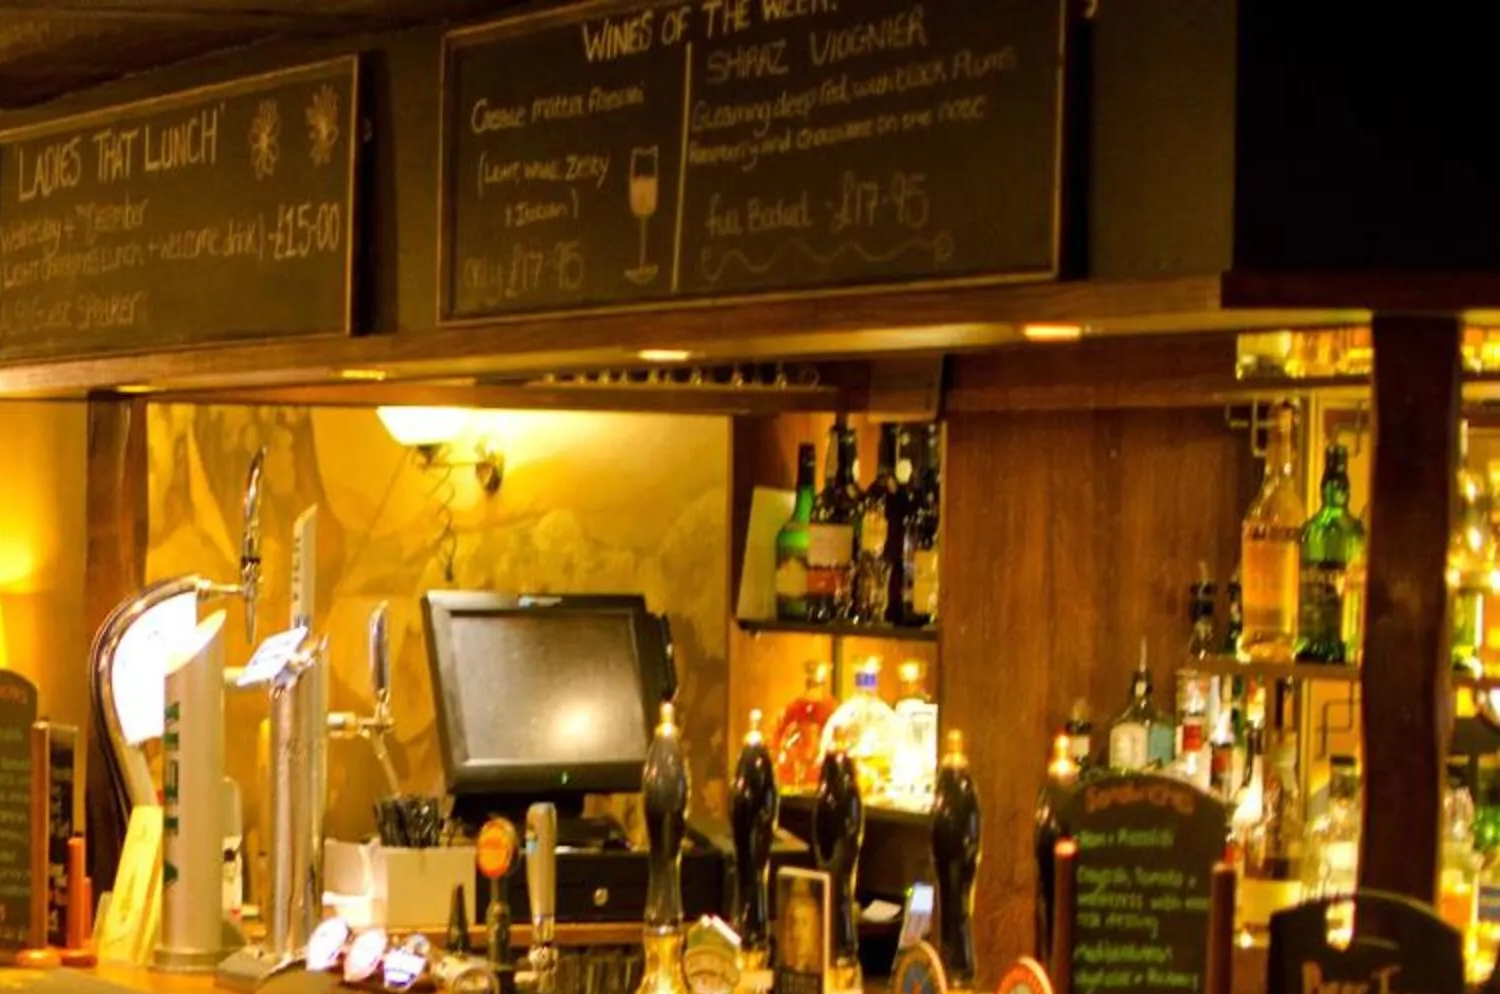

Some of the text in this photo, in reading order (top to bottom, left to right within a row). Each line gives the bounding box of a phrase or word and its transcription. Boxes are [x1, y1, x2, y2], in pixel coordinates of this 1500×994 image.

[583, 7, 654, 62] WINES
[661, 4, 693, 47] OF
[702, 0, 752, 39] THE
[706, 38, 789, 84] SHIRAZ
[18, 134, 82, 202] LADIES
[93, 126, 139, 186] THAT
